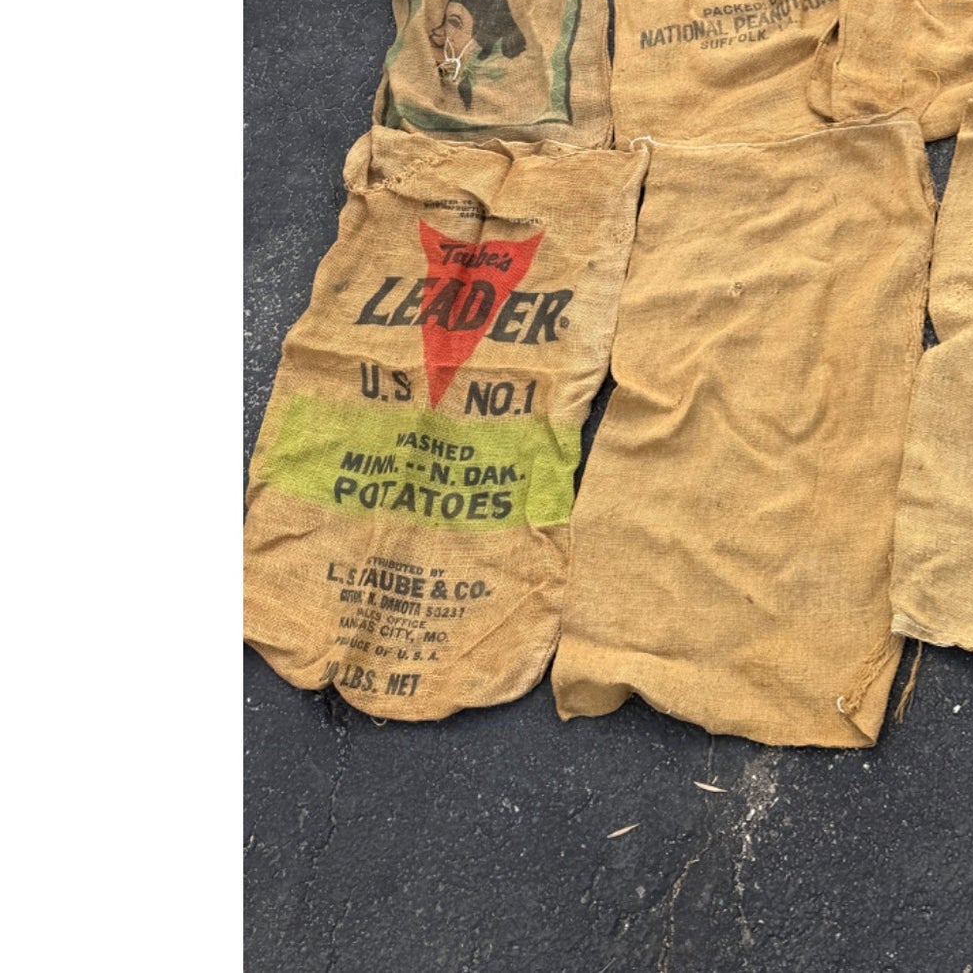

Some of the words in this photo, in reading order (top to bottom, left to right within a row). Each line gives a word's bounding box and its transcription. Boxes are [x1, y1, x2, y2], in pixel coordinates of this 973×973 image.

[703, 2, 766, 18] PACKED
[640, 19, 728, 50] NATIONAL
[700, 29, 768, 50] SUFFOLK
[440, 243, 513, 273] Taube's
[355, 277, 574, 345] LEADER
[464, 380, 537, 416] NO.1
[397, 432, 475, 461] WASHED
[340, 451, 398, 475] MINN.
[429, 462, 456, 486] N.
[464, 463, 525, 487] DAK.
[334, 476, 512, 520] POTATOES
[430, 568, 445, 577] BY
[430, 580, 449, 600] &
[454, 580, 493, 600] CO.
[380, 594, 422, 617] DAKOTA
[380, 625, 415, 643] CITY,
[423, 631, 450, 643] MO.
[387, 616, 428, 629] OFFICE
[375, 646, 392, 657] OF
[340, 664, 378, 694] LBS.
[385, 672, 422, 697] NET
